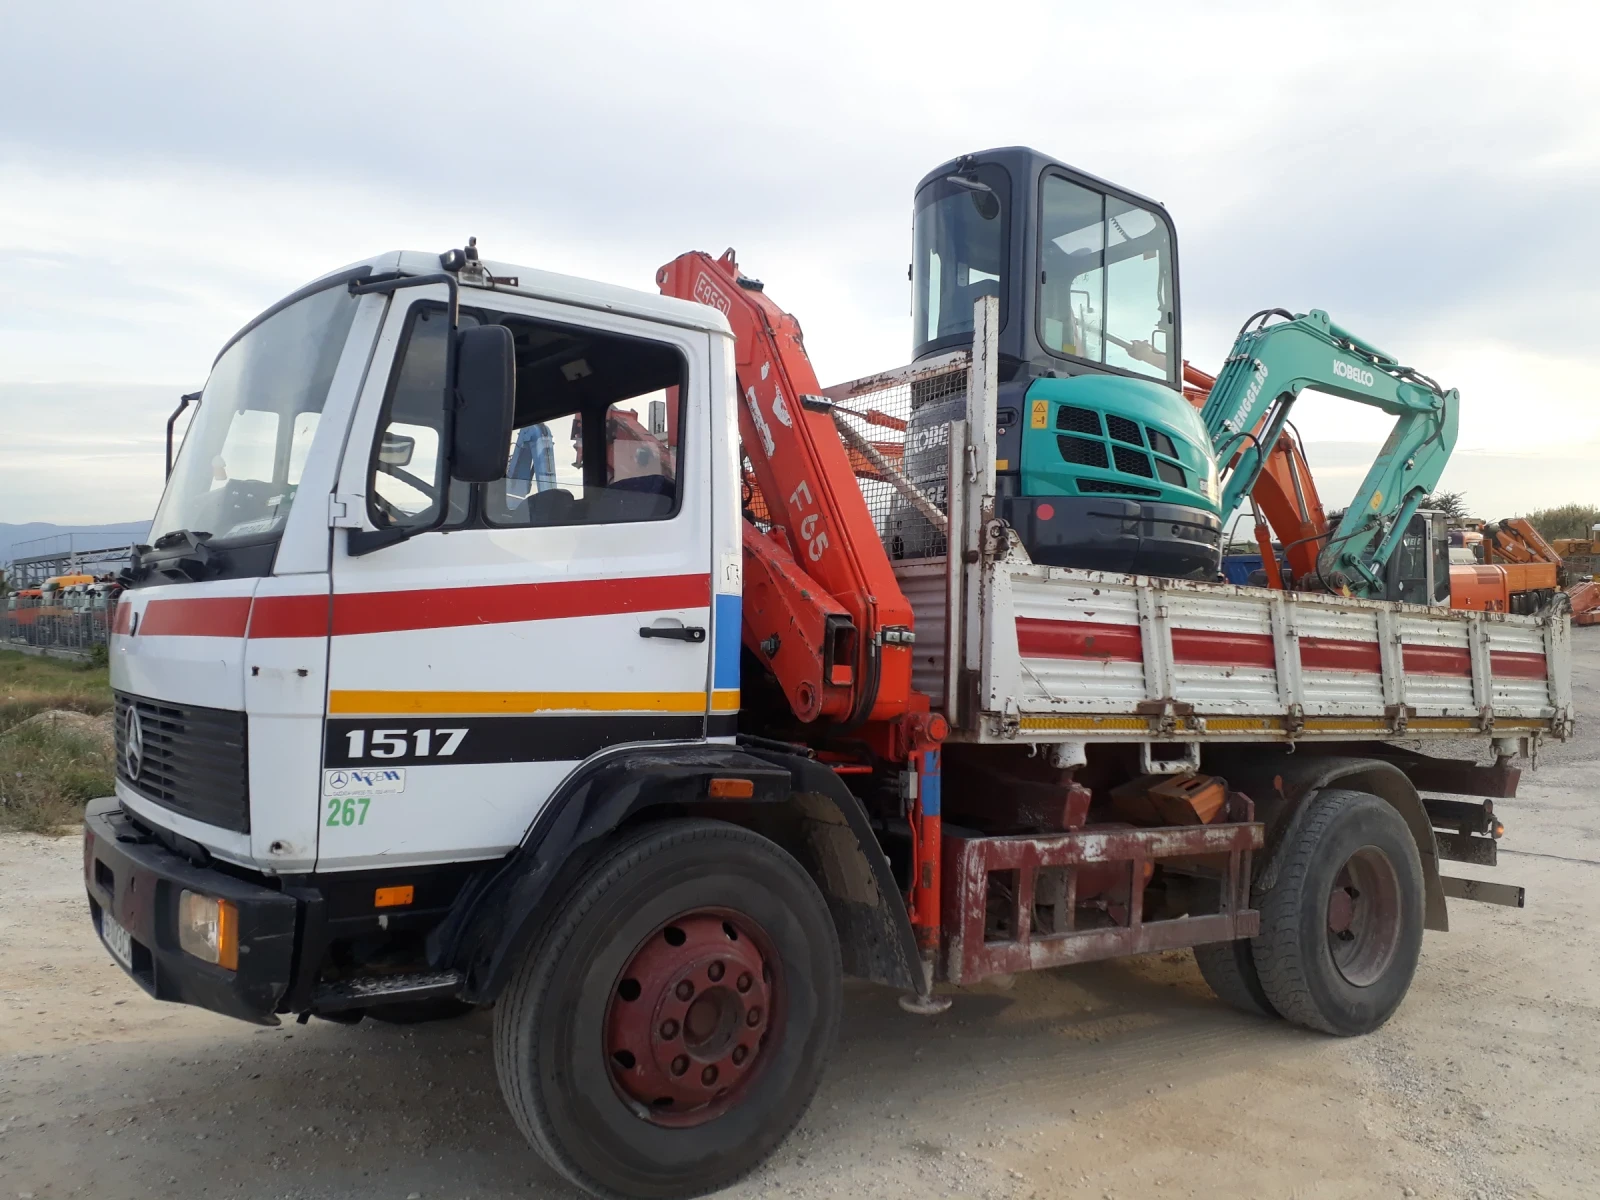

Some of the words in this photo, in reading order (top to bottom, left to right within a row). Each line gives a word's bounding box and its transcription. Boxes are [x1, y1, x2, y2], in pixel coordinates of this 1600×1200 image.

[696, 278, 728, 312] FASSI
[1333, 359, 1374, 387] KOBELCO
[789, 480, 829, 562] F65
[346, 729, 470, 758] 1517
[326, 798, 371, 827] 267
